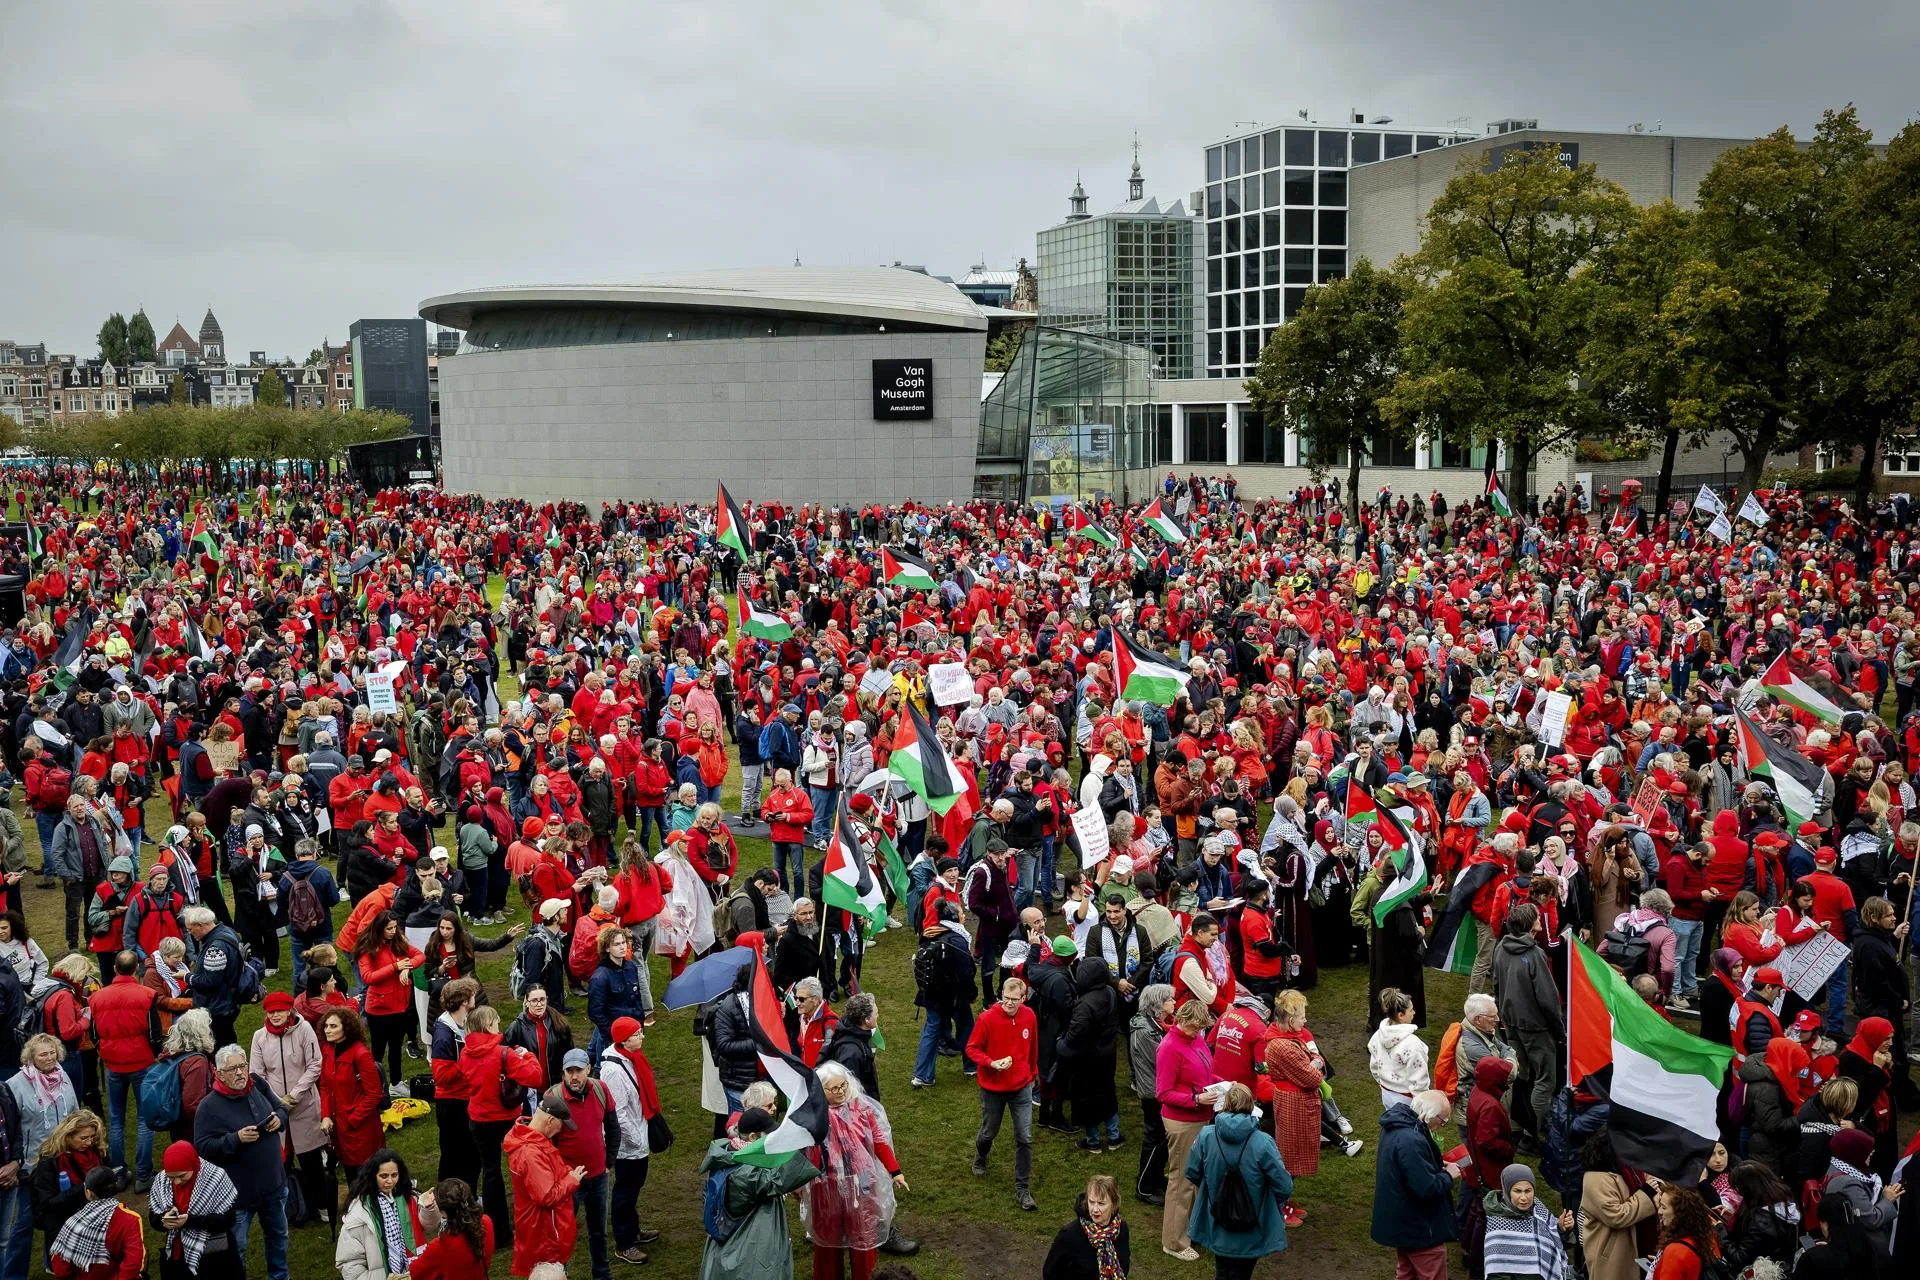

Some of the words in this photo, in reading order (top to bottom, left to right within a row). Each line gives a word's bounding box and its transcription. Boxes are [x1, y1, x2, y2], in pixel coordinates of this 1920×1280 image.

[903, 366, 924, 376] Van
[896, 377, 925, 388] Gogh
[881, 389, 925, 399] Museum
[369, 676, 388, 686] STOP
[213, 742, 233, 753] CDA
[1640, 790, 1656, 807] LOOK
[1637, 796, 1655, 814] AWAY
[1789, 970, 1800, 981] IS
[1797, 937, 1827, 968] NEVER
[1794, 941, 1848, 998] SELF-DEFENCE
